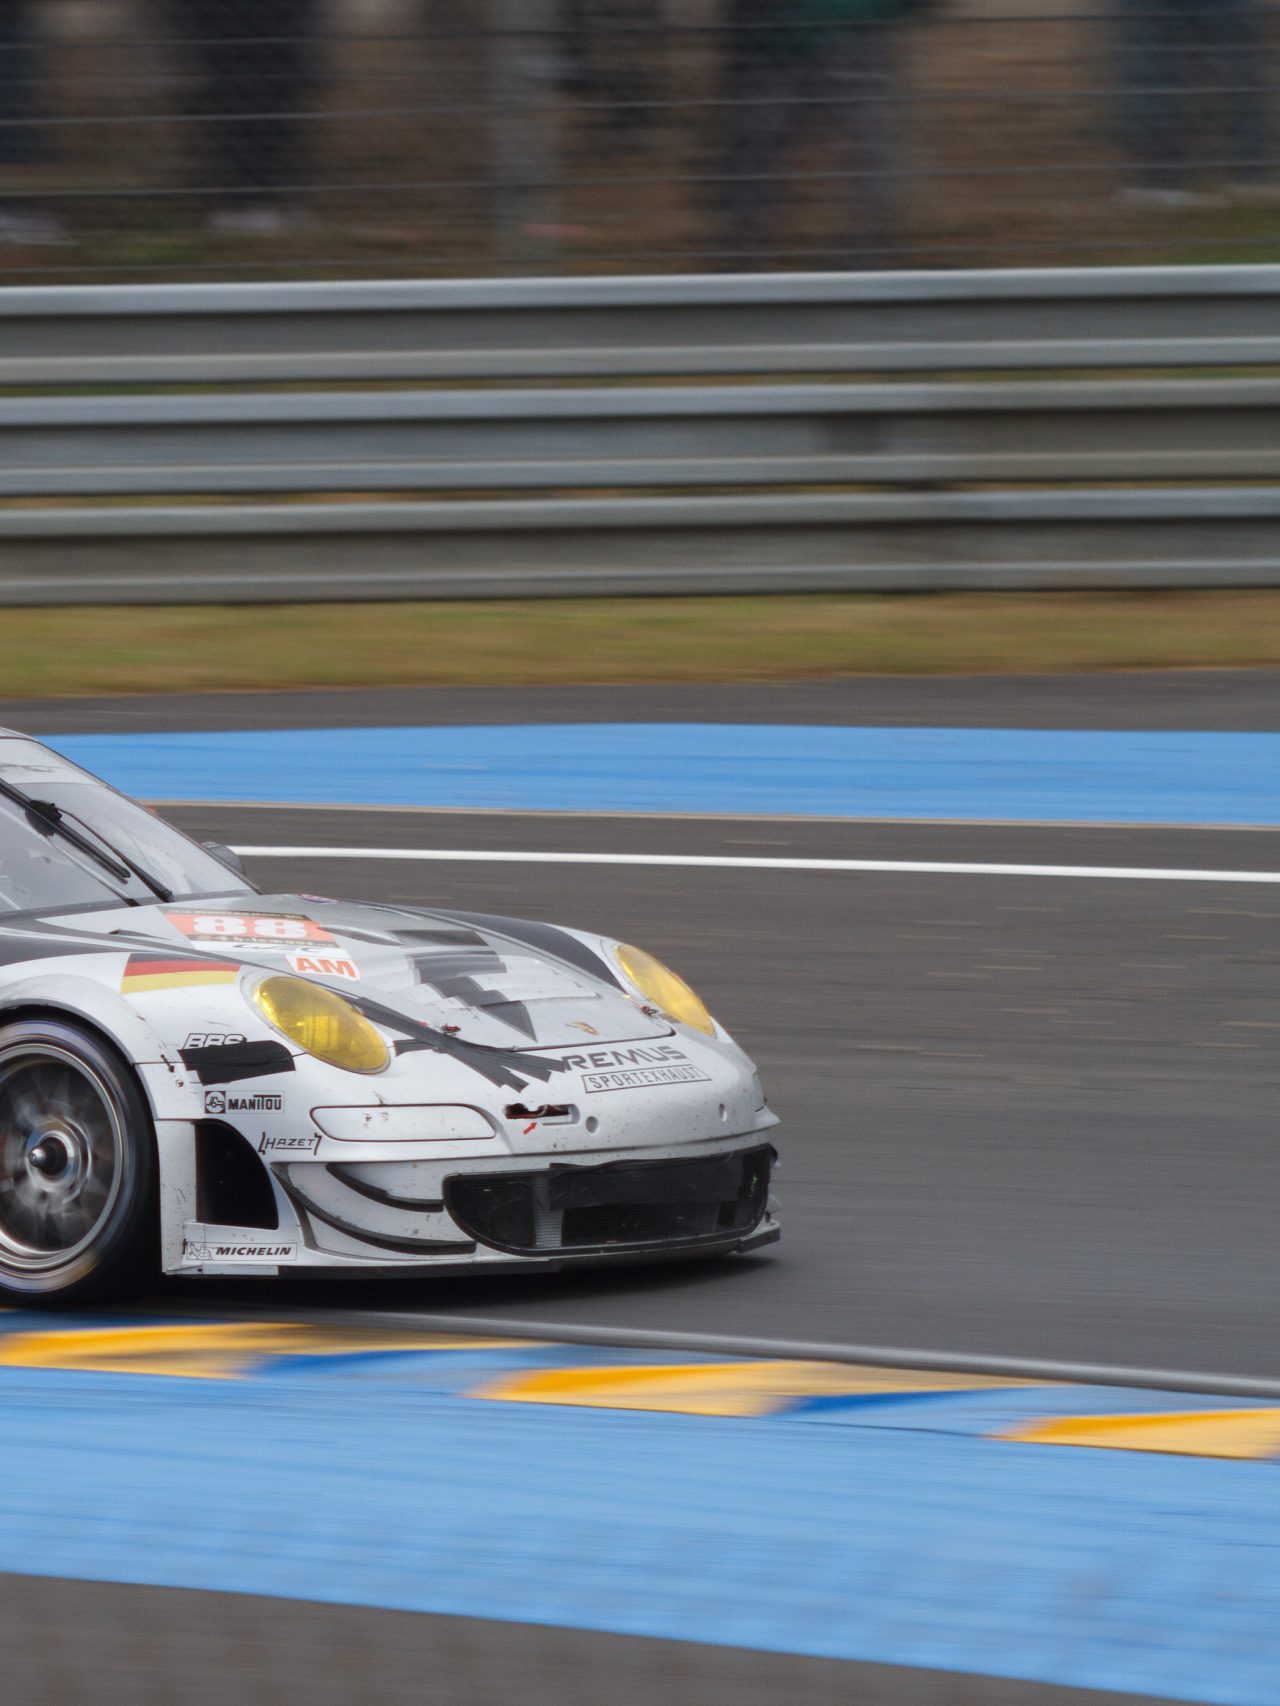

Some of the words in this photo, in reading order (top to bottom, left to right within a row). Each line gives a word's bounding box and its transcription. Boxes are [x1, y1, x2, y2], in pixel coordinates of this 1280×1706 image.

[192, 916, 308, 939] 88
[295, 957, 357, 979] AM
[562, 1045, 688, 1070] REMUS
[588, 1066, 702, 1089] SPORTEXHAUST
[228, 1095, 282, 1110] MANITOU
[263, 1135, 317, 1150] HAZET
[216, 1247, 291, 1256] MICHELIN
